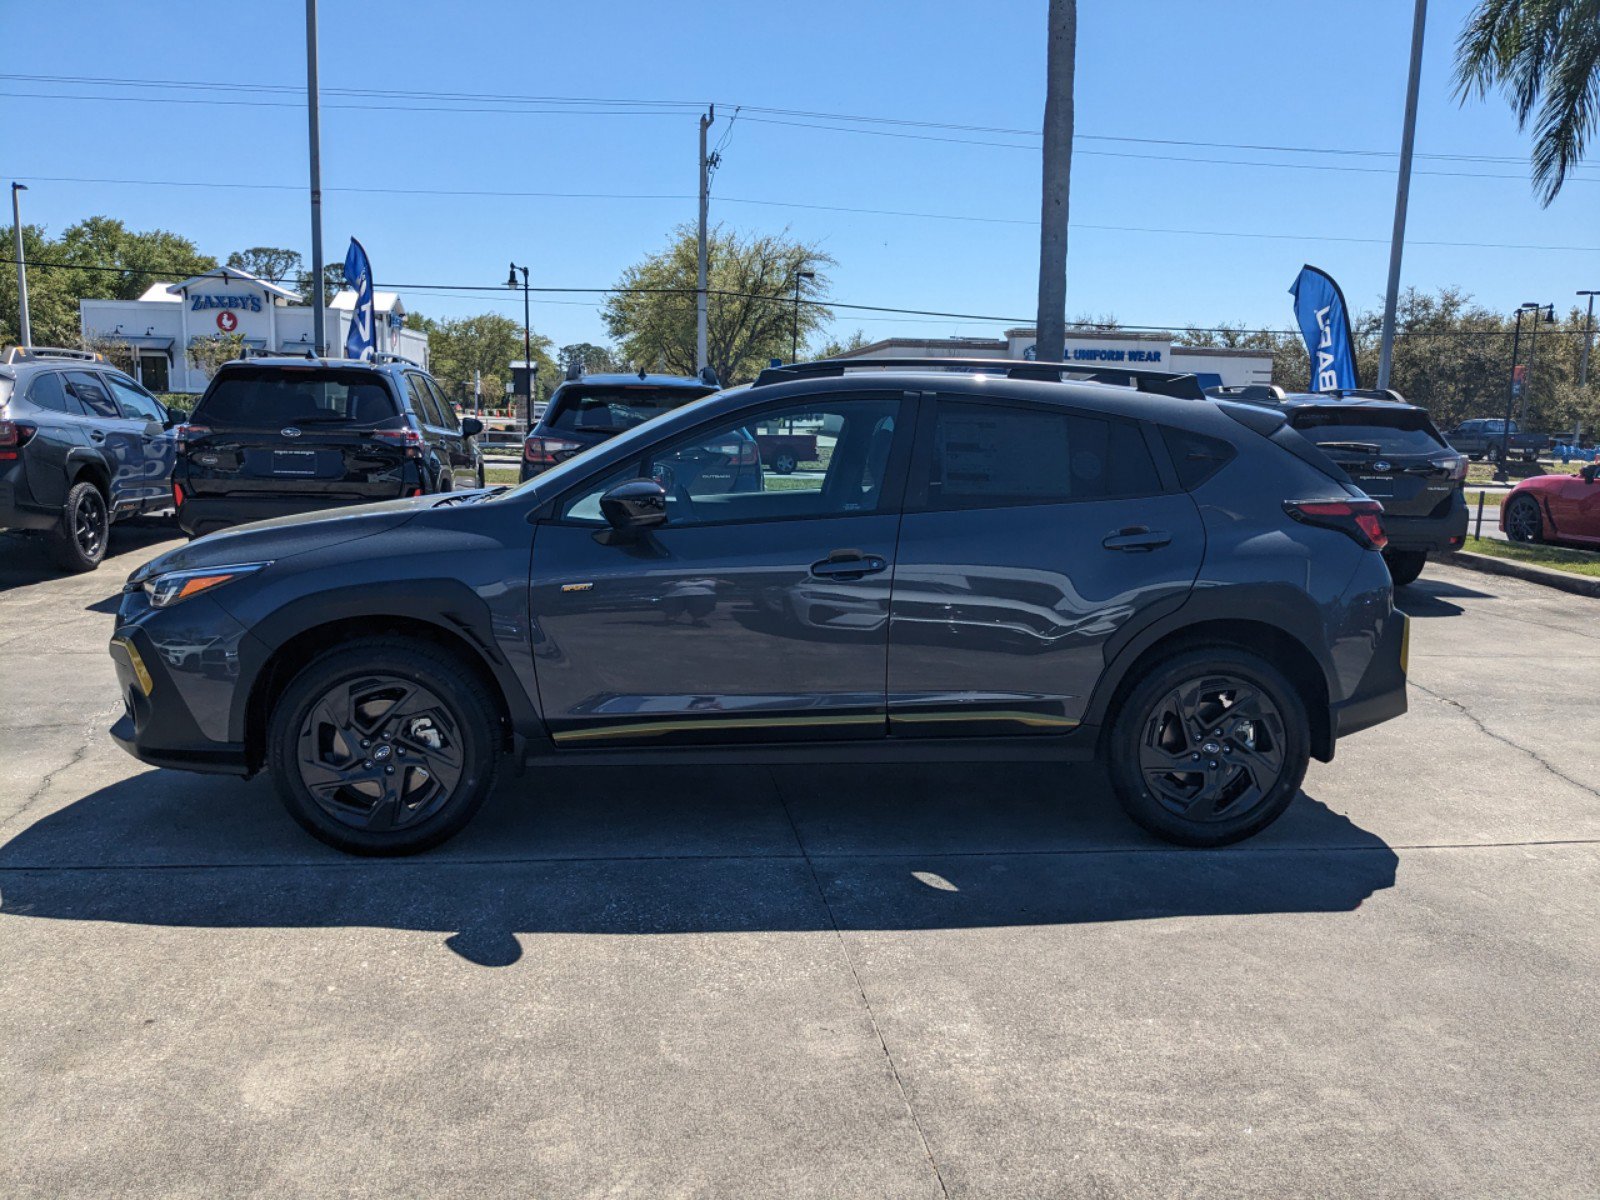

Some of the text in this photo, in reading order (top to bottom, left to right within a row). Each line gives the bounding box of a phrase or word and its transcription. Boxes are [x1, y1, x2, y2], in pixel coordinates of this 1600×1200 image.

[191, 294, 262, 312] ZAXBY'S
[1074, 349, 1125, 362] UNIFORM
[1128, 350, 1161, 362] WEAR
